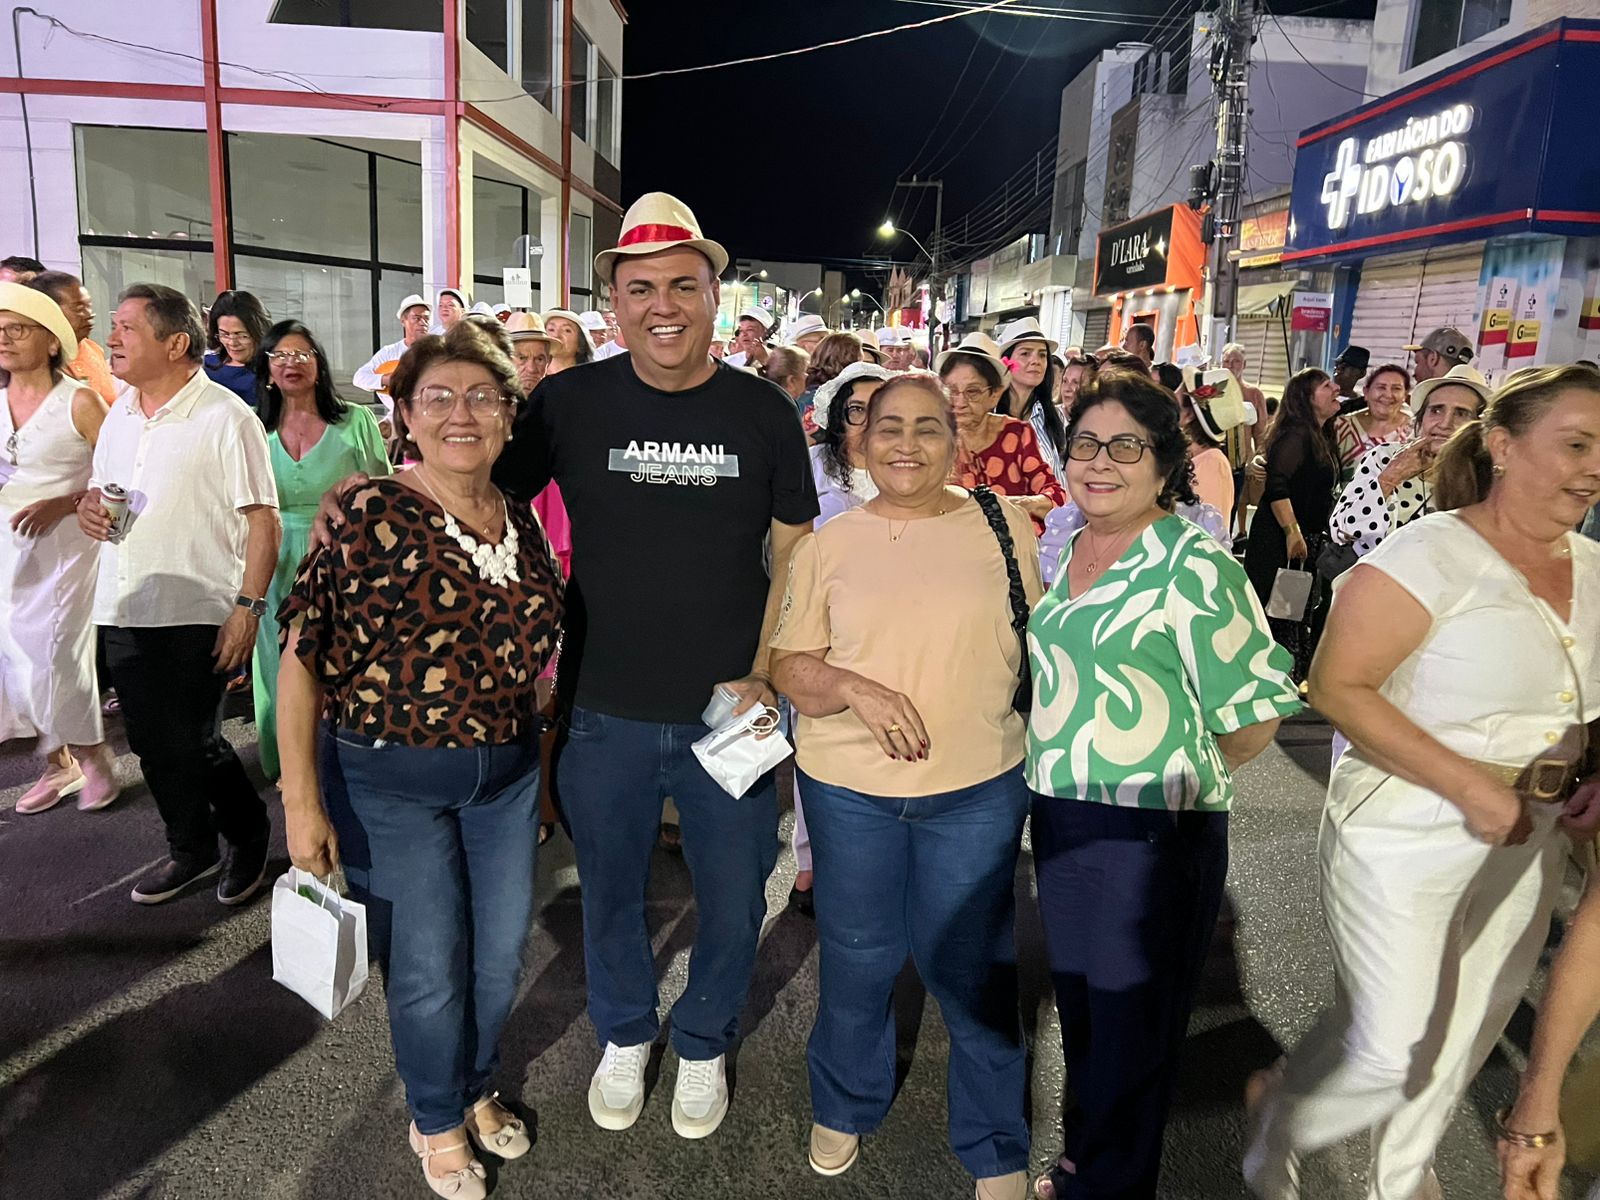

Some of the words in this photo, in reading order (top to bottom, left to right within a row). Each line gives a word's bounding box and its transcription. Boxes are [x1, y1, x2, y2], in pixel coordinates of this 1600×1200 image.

[1439, 104, 1471, 138] DO
[1357, 141, 1463, 215] IDOSO
[1110, 231, 1148, 267] D'LARA
[623, 440, 725, 465] ARMANI
[630, 463, 718, 486] JEANS
